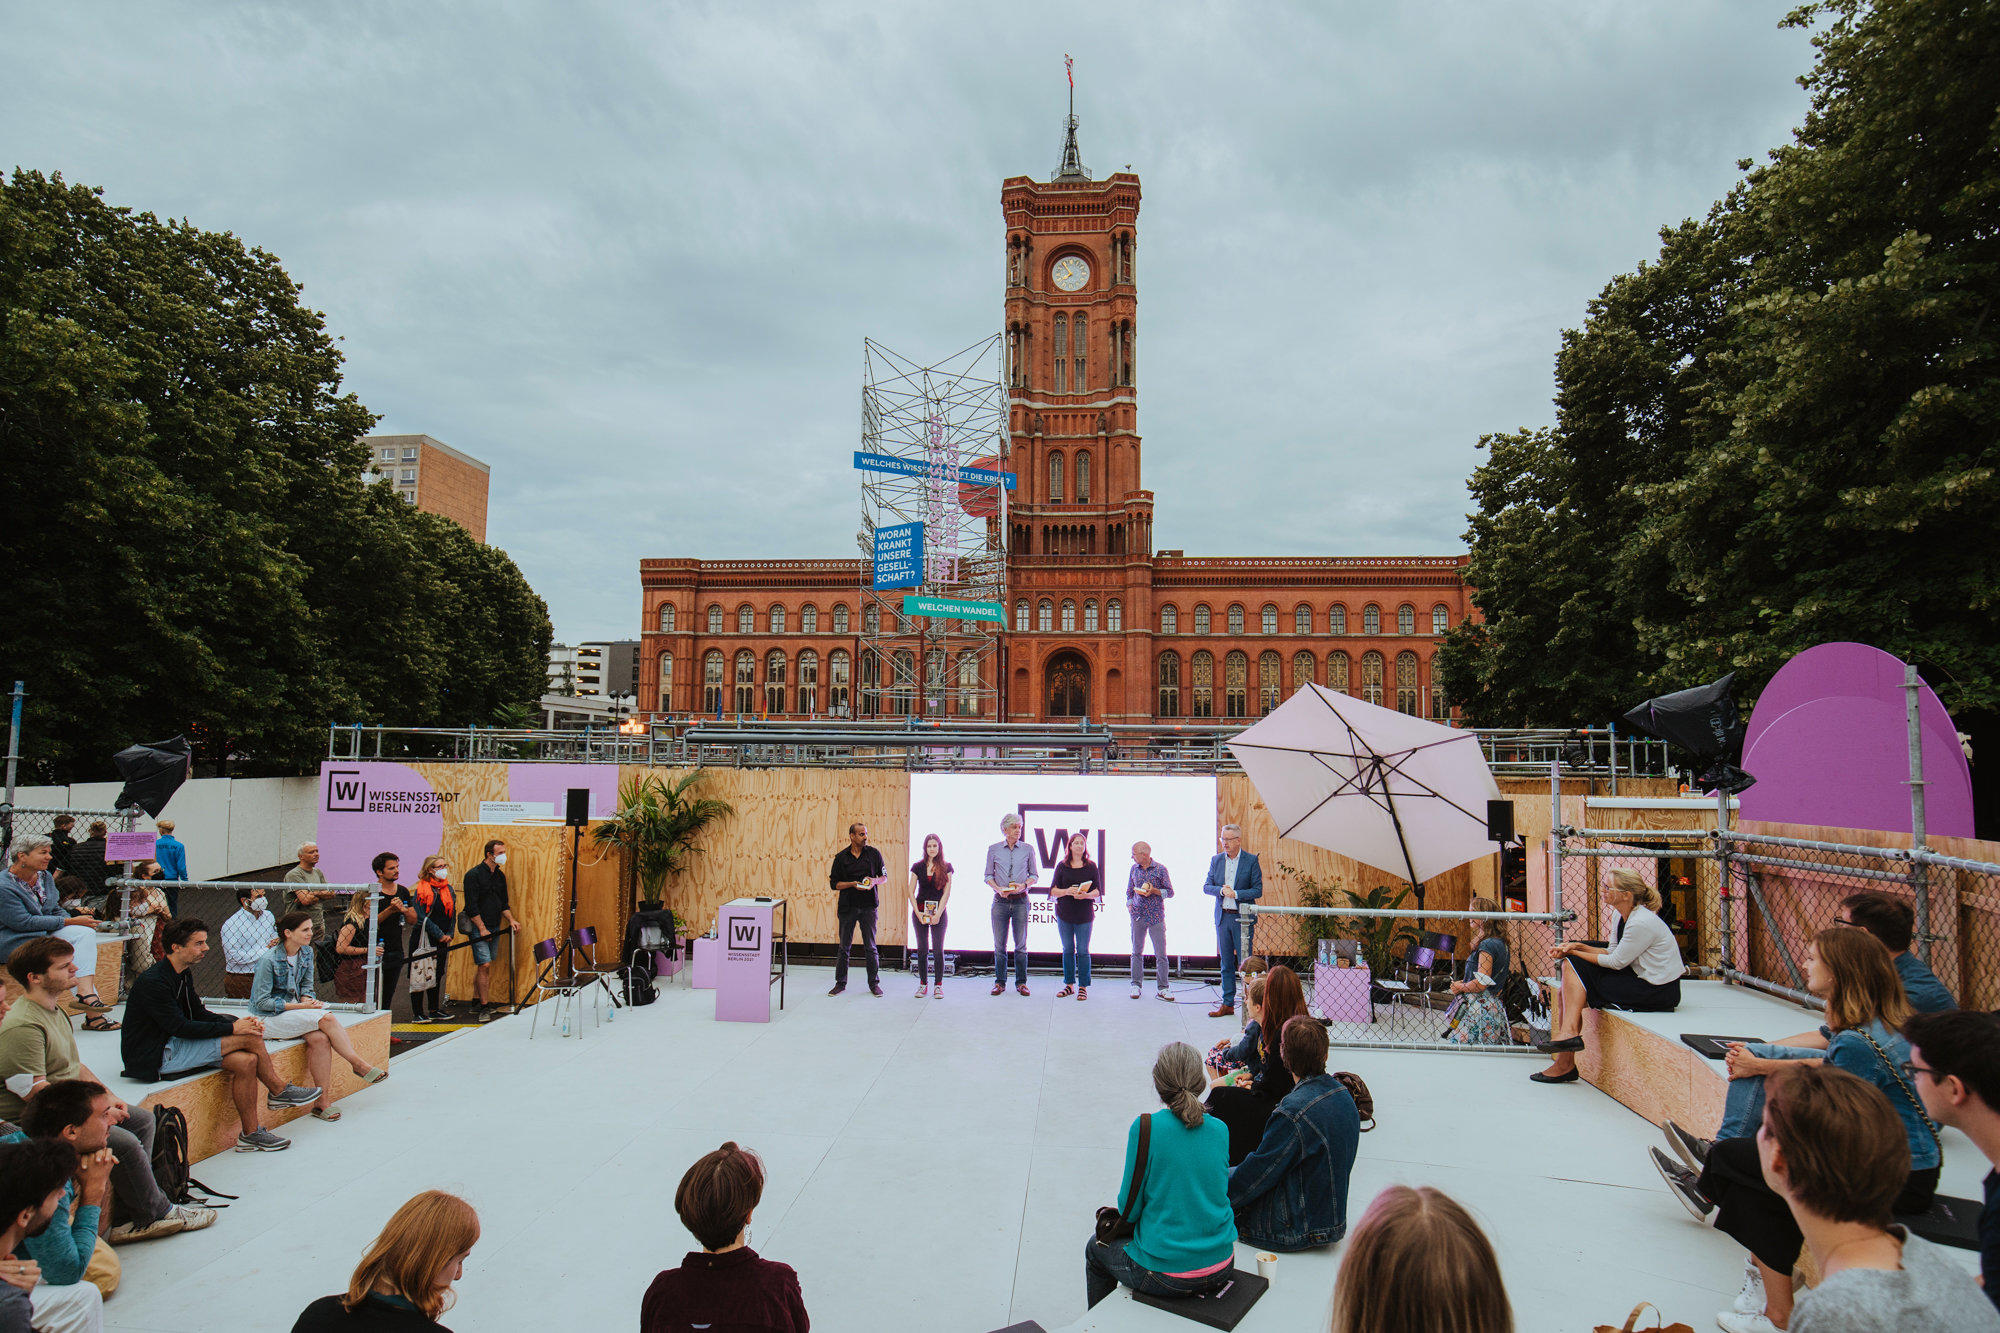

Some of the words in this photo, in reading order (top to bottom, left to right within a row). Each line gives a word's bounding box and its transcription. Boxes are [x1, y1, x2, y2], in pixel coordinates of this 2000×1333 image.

[861, 457, 902, 470] WELCHES
[946, 443, 959, 481] 2021
[945, 485, 959, 548] BERLIN
[878, 528, 911, 540] WORAN
[878, 538, 912, 551] KRANKT
[878, 549, 911, 561] UNSERE
[877, 561, 912, 572] GESELL-
[877, 571, 915, 583] SCHAFT?
[918, 602, 960, 613] WELCHEN
[962, 606, 997, 616] WANDEL
[335, 782, 360, 800] W
[369, 791, 460, 802] WISSENSSTADT
[368, 803, 411, 812] BERLIN
[414, 804, 441, 813] 2021
[1034, 828, 1089, 868] W
[735, 926, 755, 941] W
